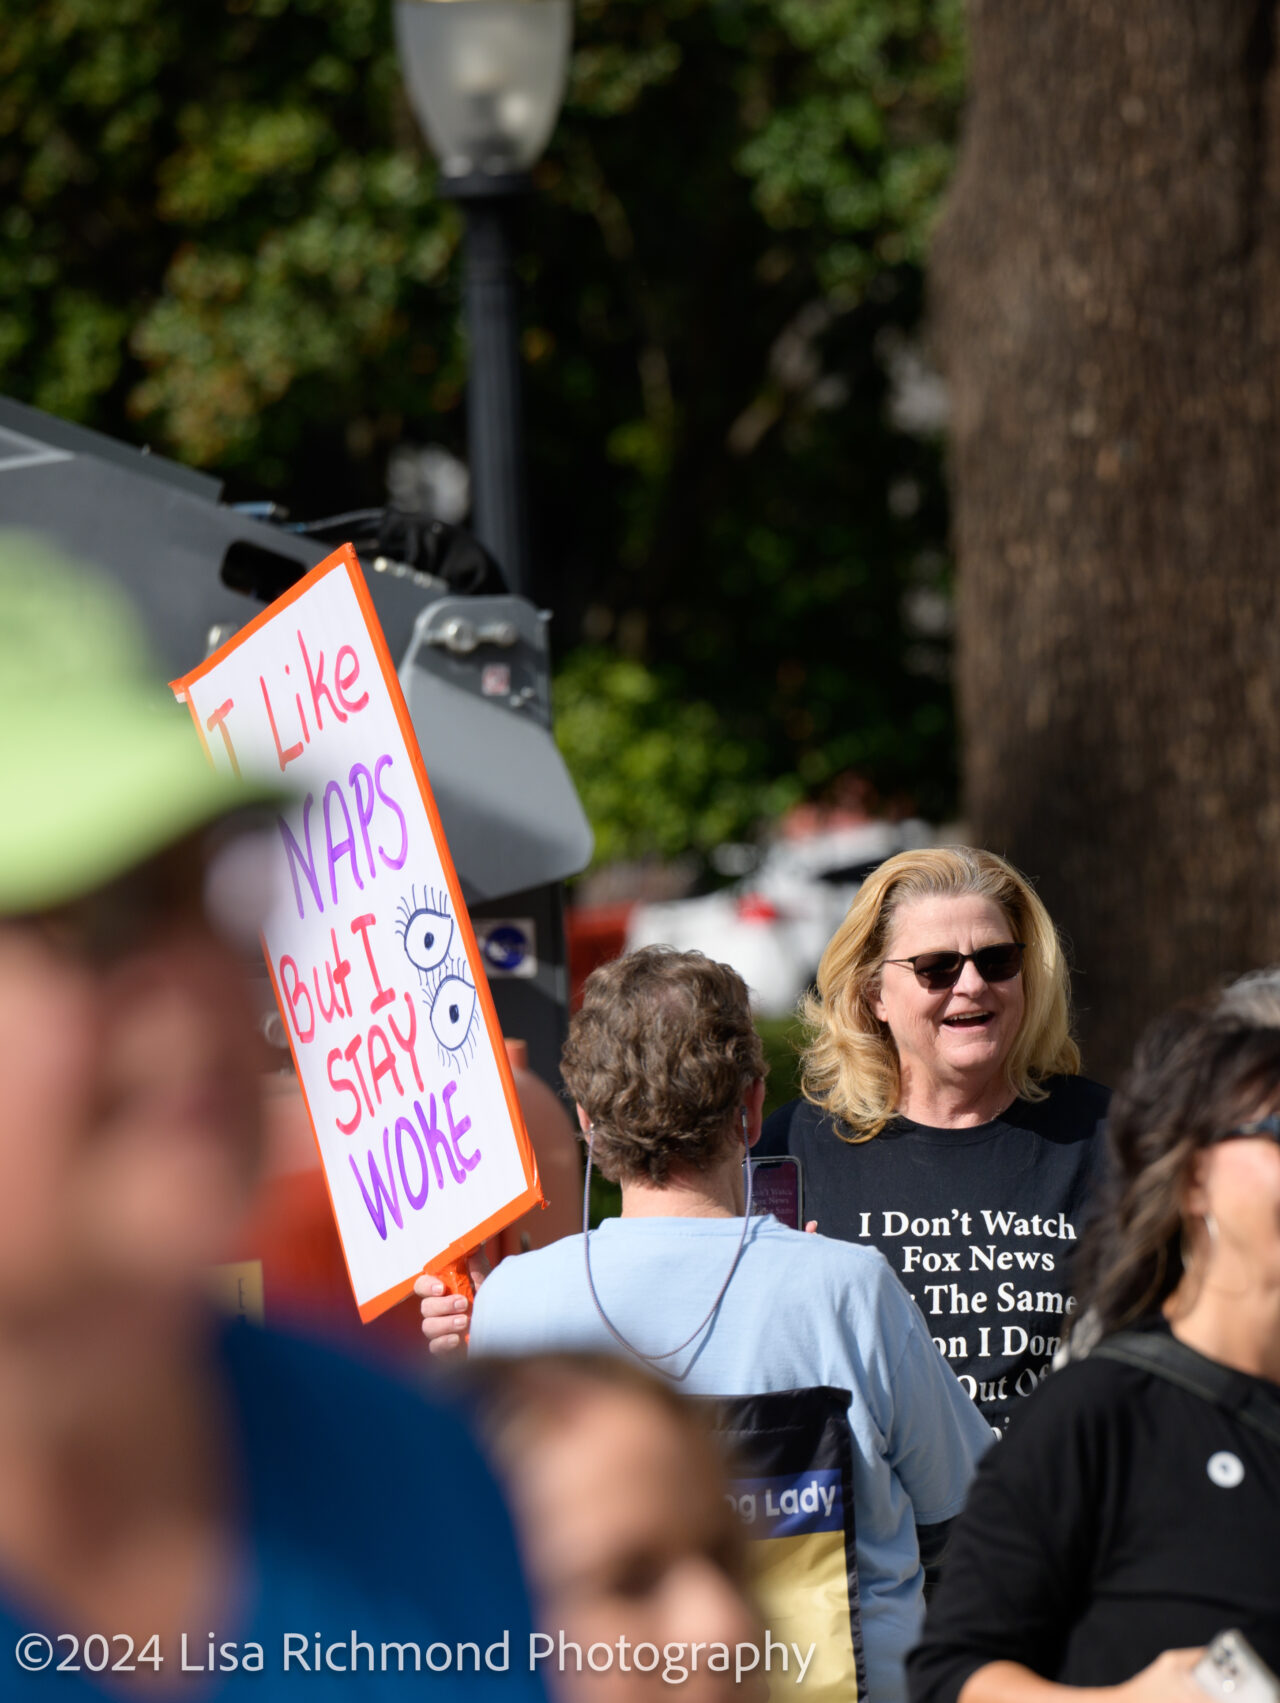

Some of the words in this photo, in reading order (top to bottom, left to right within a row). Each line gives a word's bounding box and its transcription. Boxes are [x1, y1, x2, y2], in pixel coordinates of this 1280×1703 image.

[277, 754, 408, 919] NAPS
[351, 913, 396, 1015] I
[326, 991, 425, 1135] STAY
[349, 1080, 482, 1241] WOKE
[858, 1212, 872, 1238] I
[980, 1209, 1078, 1240] Watch
[902, 1245, 961, 1273] Fox
[969, 1244, 1055, 1272] News
[924, 1283, 988, 1315] The
[996, 1281, 1079, 1316] Same
[978, 1327, 991, 1357] I
[765, 1480, 837, 1518] Lady
